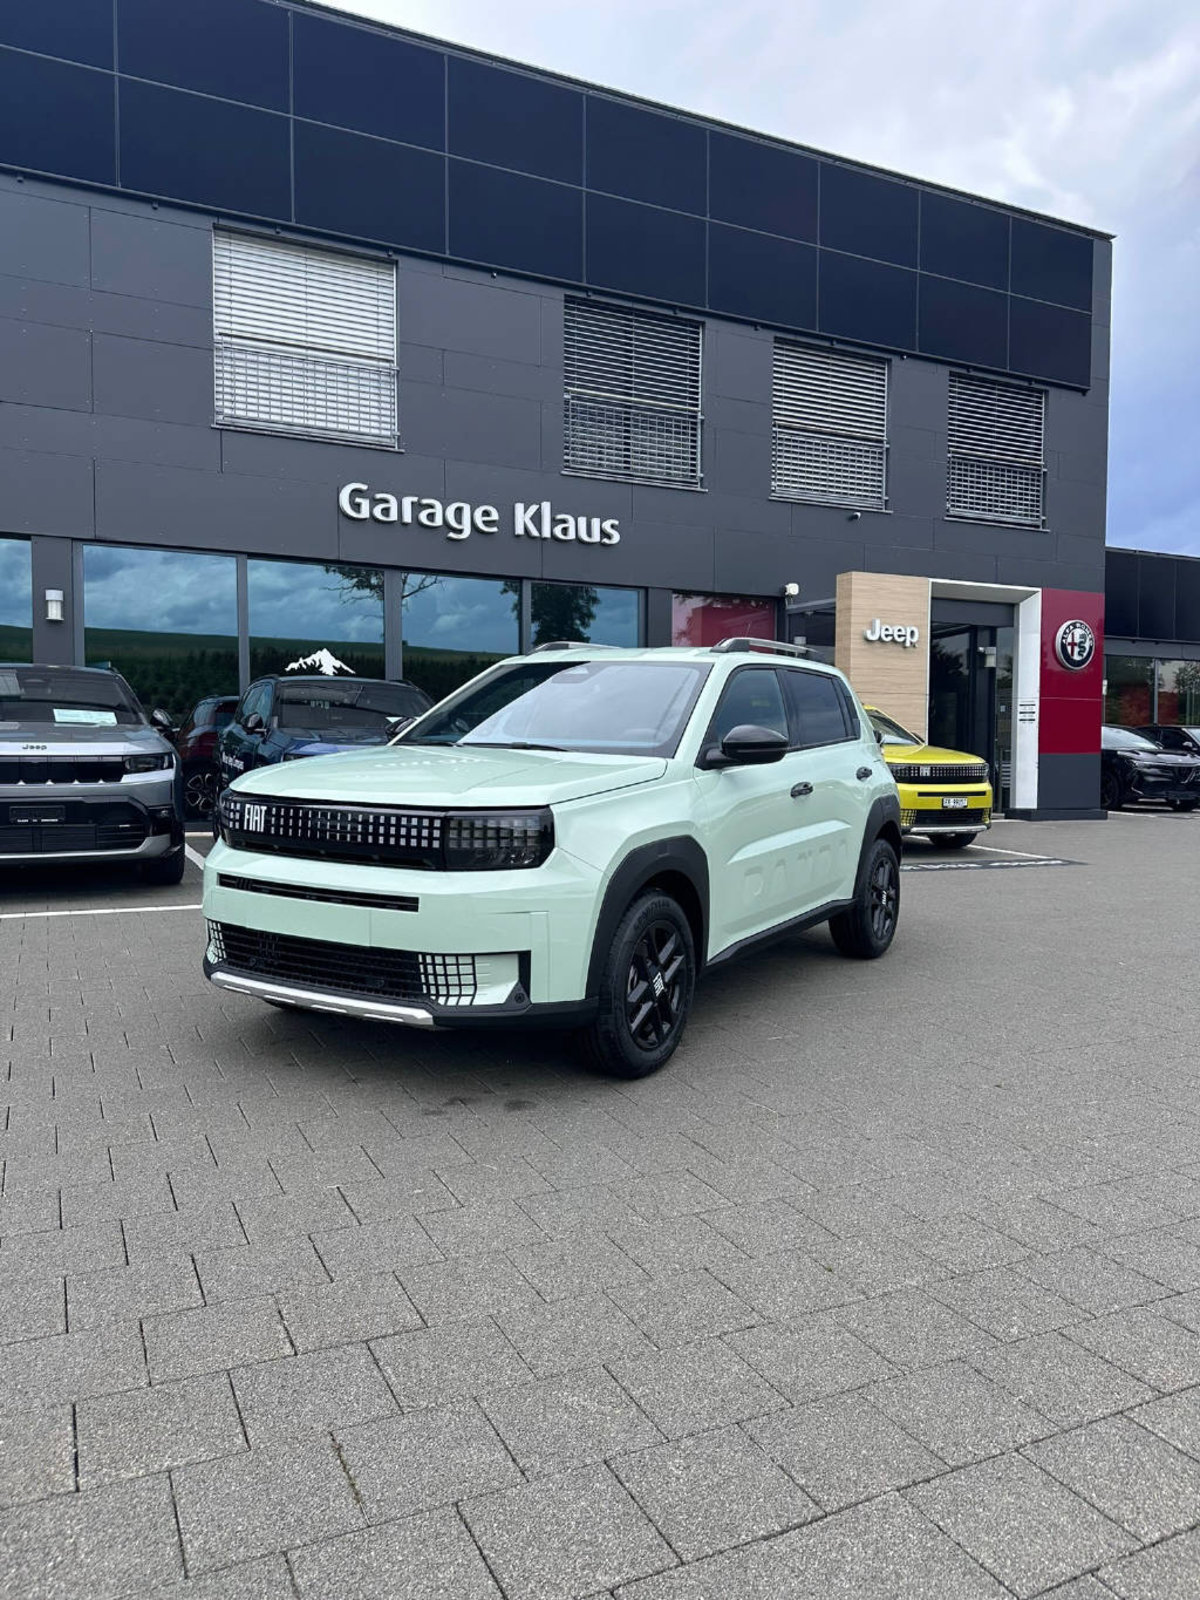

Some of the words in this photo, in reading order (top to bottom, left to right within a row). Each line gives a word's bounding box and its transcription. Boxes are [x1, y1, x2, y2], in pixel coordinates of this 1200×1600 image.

[338, 482, 500, 540] Garage
[514, 501, 621, 545] Klaus
[864, 617, 919, 647] Jeep
[243, 803, 267, 832] FIAT
